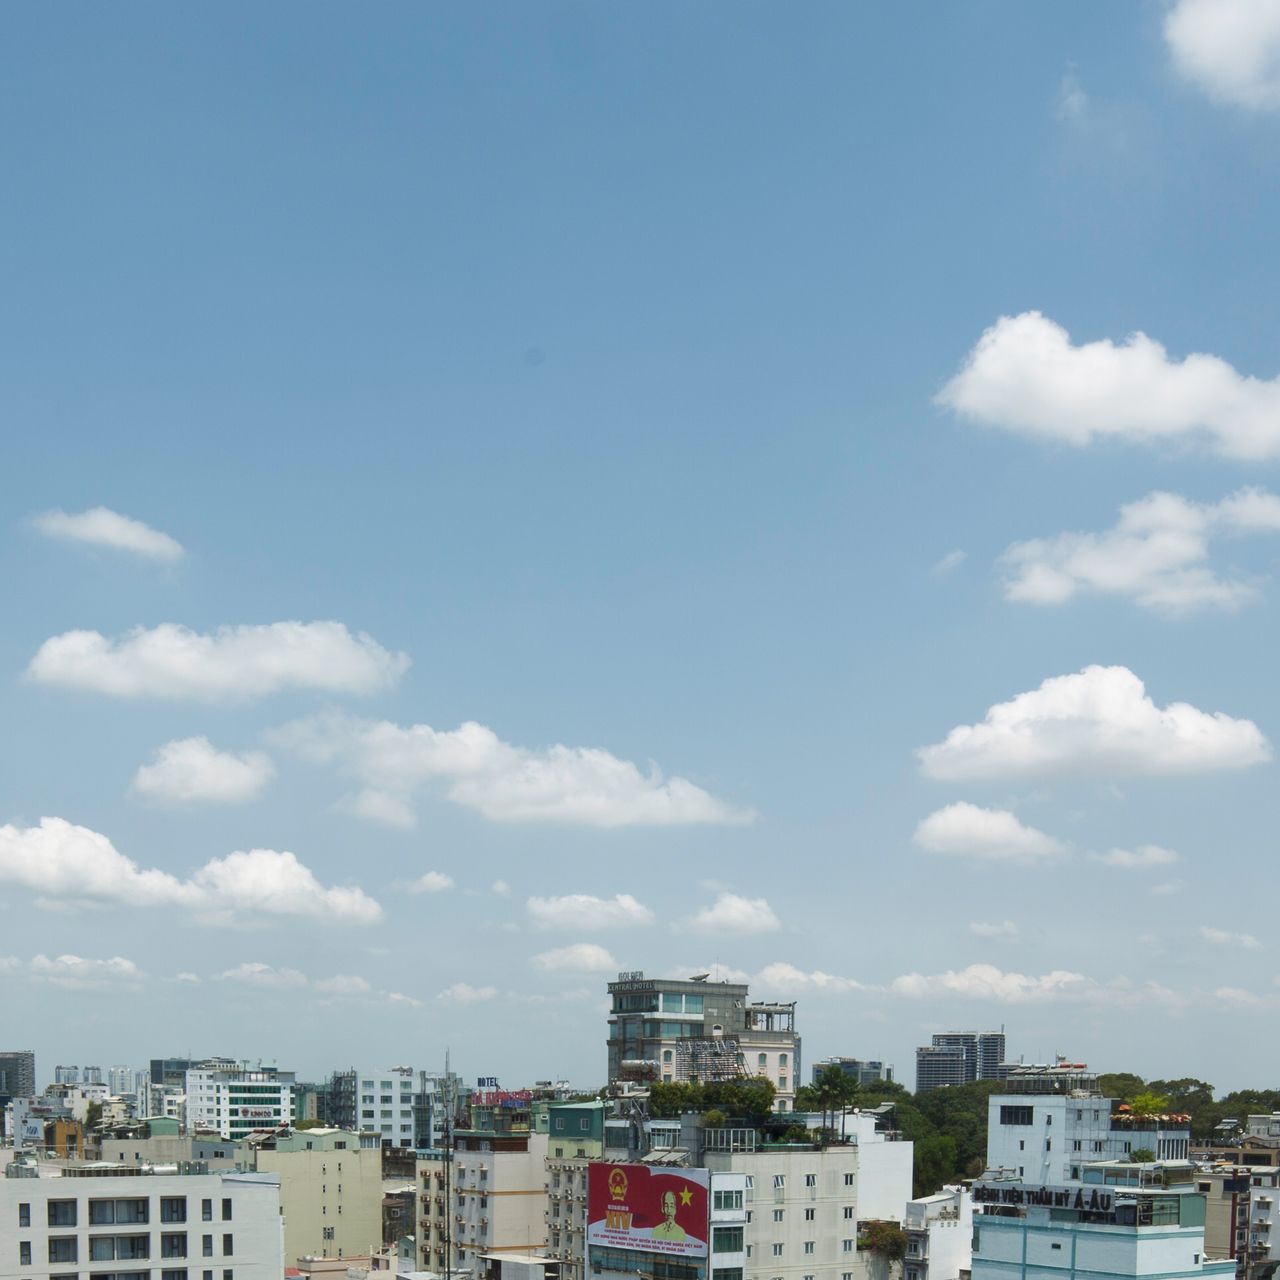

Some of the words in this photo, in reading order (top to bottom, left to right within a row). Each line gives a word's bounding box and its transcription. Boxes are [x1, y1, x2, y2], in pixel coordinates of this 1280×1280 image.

[618, 971, 644, 981] GOLDEN
[608, 982, 633, 992] CENTRAL
[634, 982, 653, 990] HOTEL
[477, 1077, 497, 1087] HOTEL
[605, 1210, 633, 1230] XIV
